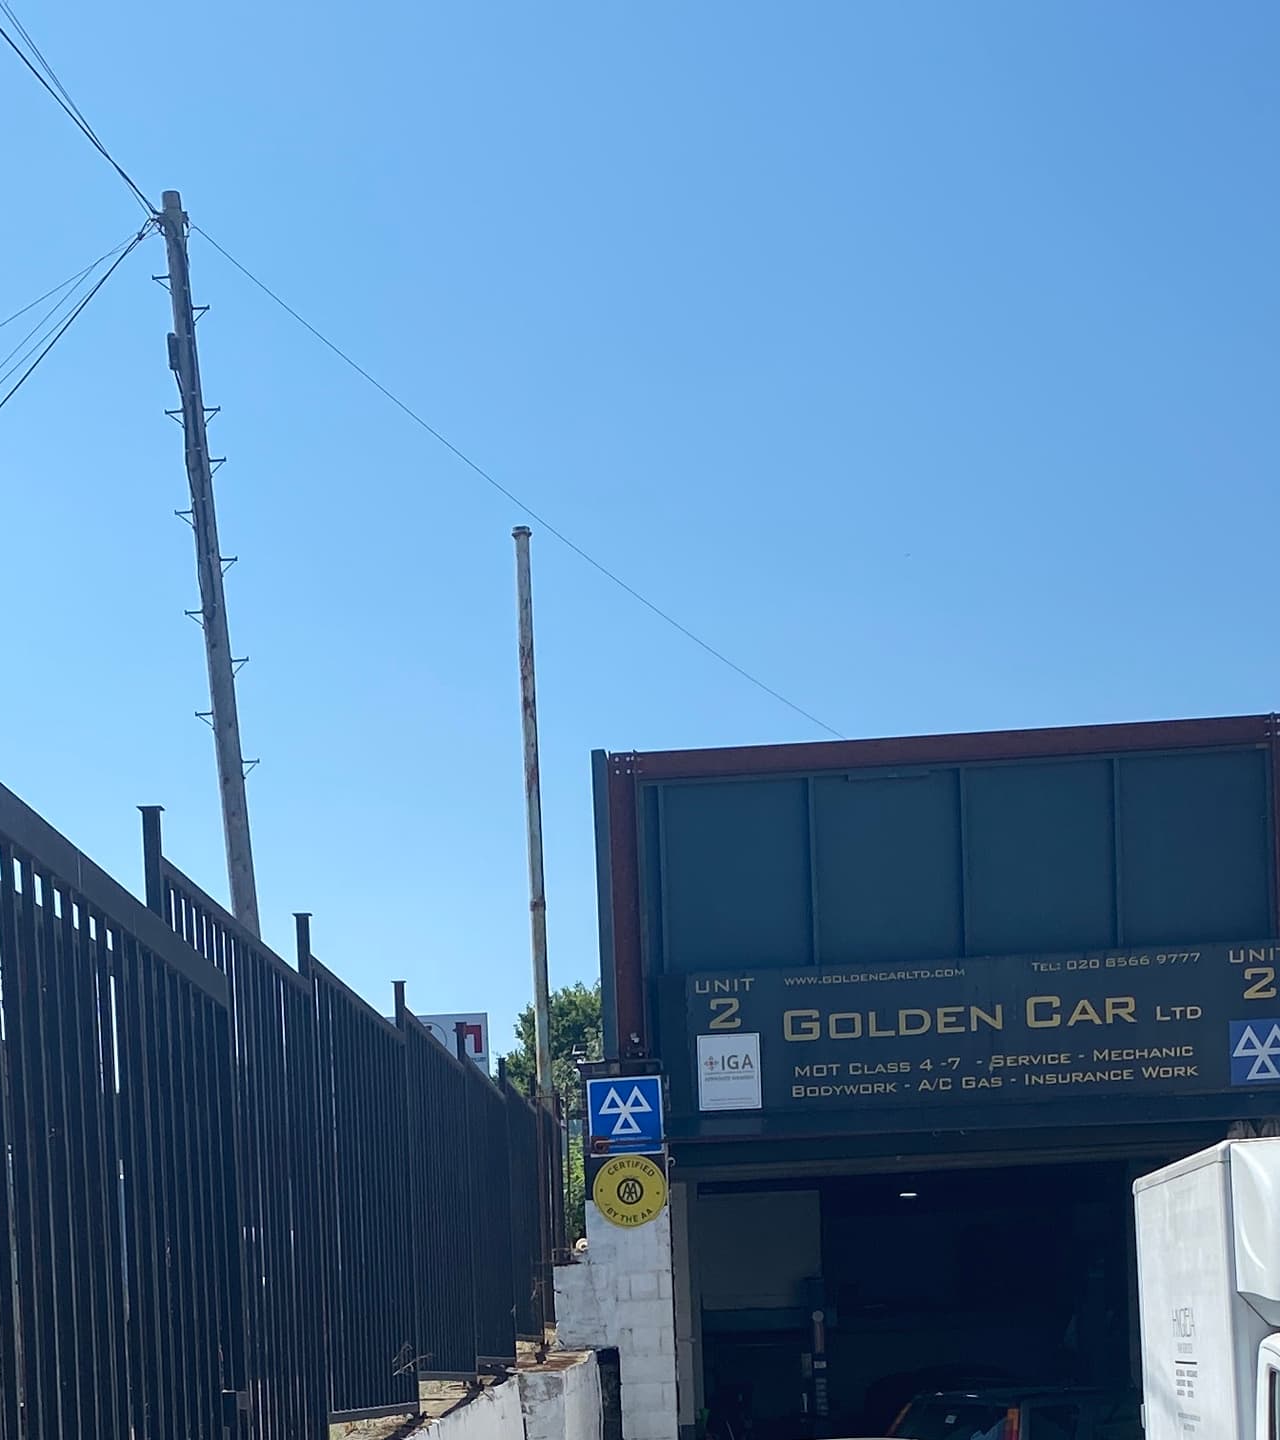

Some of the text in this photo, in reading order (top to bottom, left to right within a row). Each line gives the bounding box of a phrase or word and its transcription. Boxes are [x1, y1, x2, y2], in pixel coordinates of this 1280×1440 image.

[1067, 958, 1099, 971] 020
[1156, 952, 1201, 966] 9777
[695, 977, 755, 993] UNIT
[1243, 967, 1277, 1000] 2
[708, 997, 742, 1031] 2
[783, 995, 1202, 1042] GOLDEN CAR LTD
[722, 1054, 753, 1071] IGA
[795, 1064, 841, 1078] MOT
[849, 1062, 910, 1075] CLASS
[919, 1059, 933, 1071] 4
[991, 1053, 1071, 1068] SERVICE
[1093, 1046, 1193, 1062] MECHANIC
[792, 1082, 896, 1098] BODYWORK
[918, 1077, 952, 1092] A/C
[962, 1076, 1002, 1089] GAS
[1024, 1068, 1134, 1086] INSURANCE
[1142, 1064, 1199, 1080] WORK
[607, 1159, 655, 1178] CERTIFIED
[606, 1207, 653, 1223] BY THE AA
